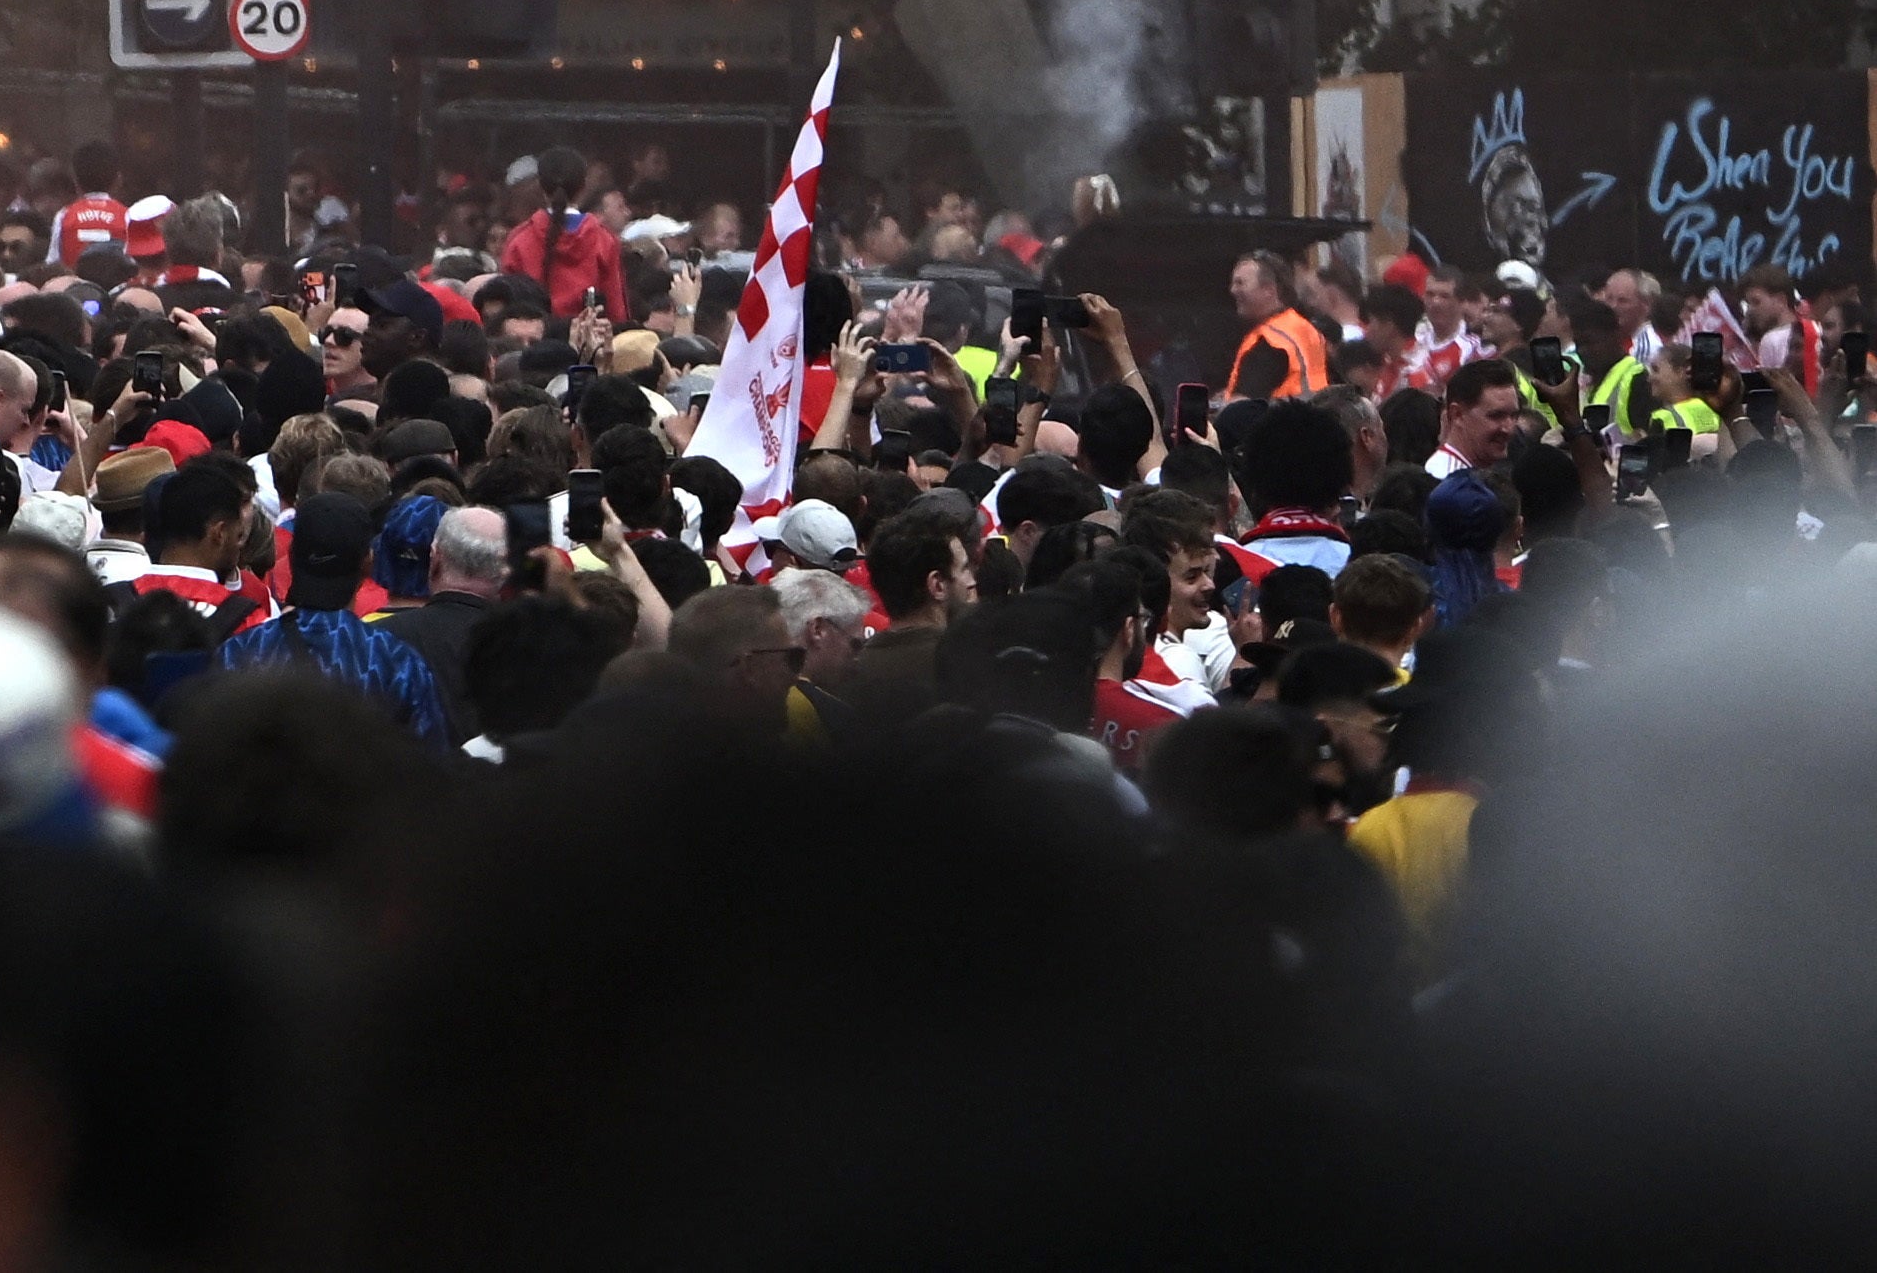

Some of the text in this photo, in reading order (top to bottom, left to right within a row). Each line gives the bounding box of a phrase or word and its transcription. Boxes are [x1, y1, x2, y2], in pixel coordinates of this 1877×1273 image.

[243, 0, 300, 34] 20
[1648, 97, 1854, 225] When You
